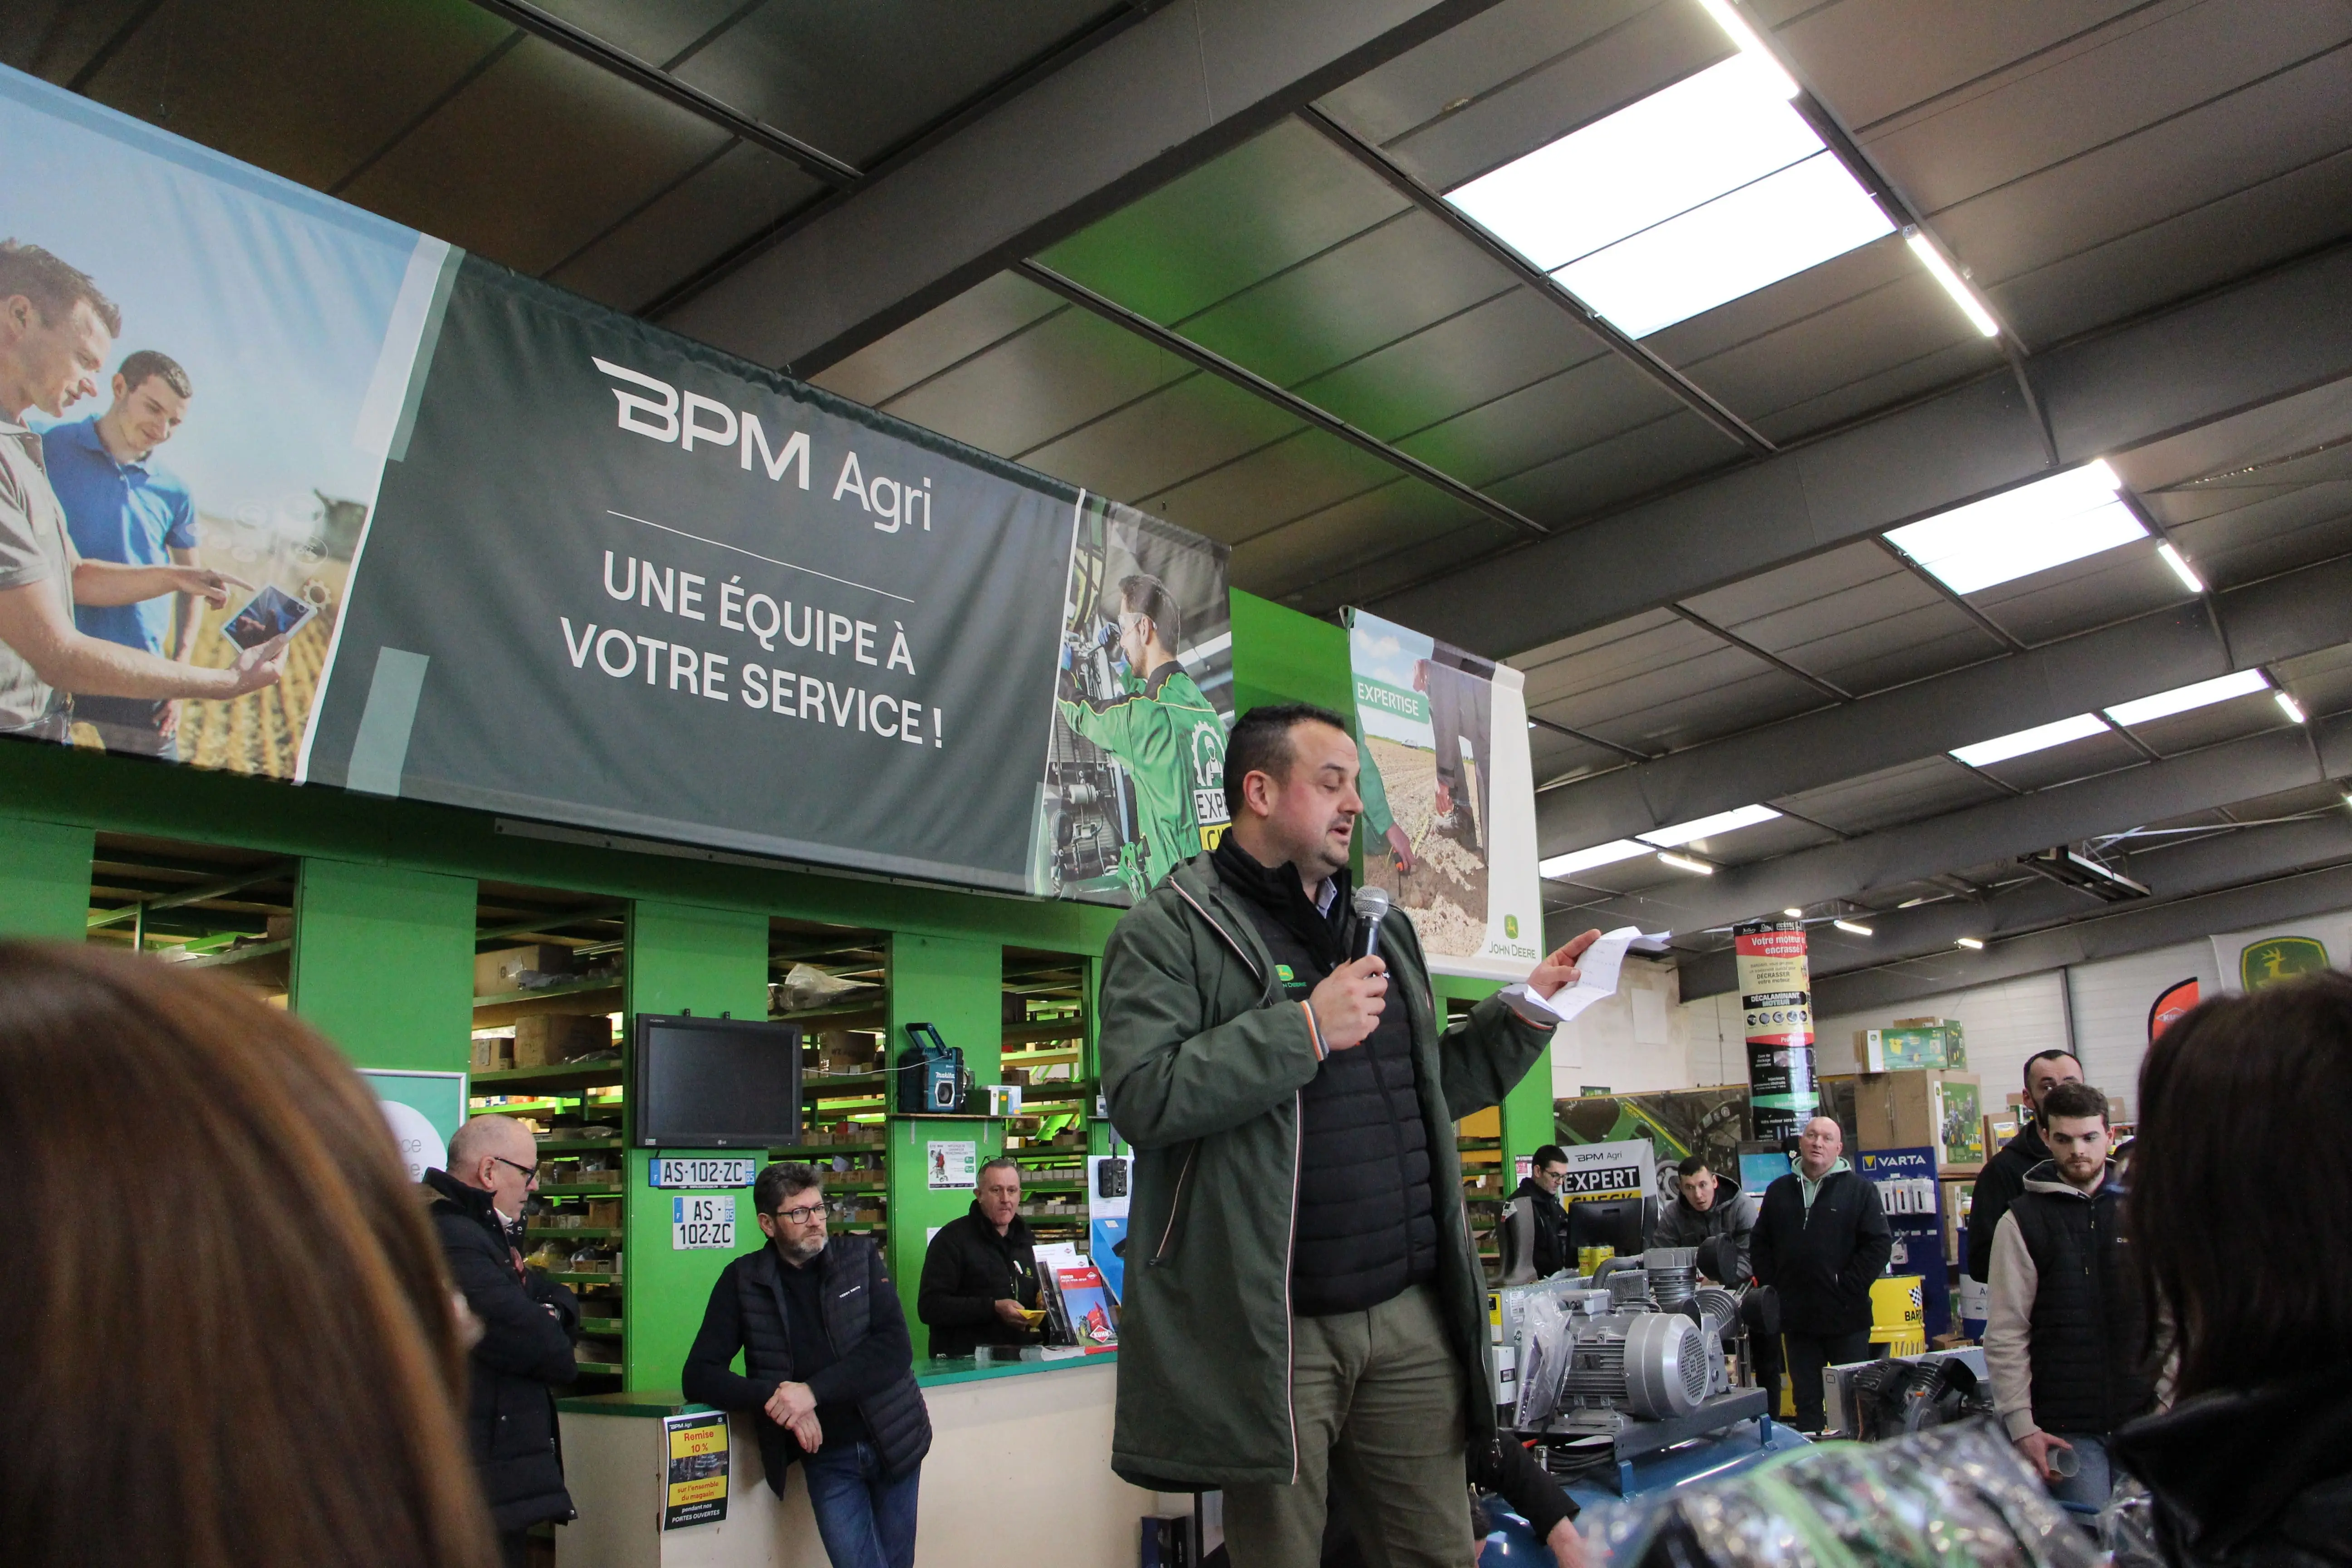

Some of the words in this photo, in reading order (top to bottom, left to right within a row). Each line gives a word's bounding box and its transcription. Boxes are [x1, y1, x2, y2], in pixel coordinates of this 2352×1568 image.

[591, 356, 810, 490] BPM
[833, 451, 931, 533] Agri
[604, 550, 705, 622] UNE
[720, 575, 877, 666] ÉQUIPE
[887, 620, 916, 675] À
[560, 617, 729, 701] VOTRE
[741, 663, 923, 745] SERVICE
[933, 707, 942, 749] !
[1357, 682, 1419, 716] EXPERTISE
[1751, 937, 1774, 946] Votre
[1489, 941, 1510, 956] JOHN
[1511, 944, 1536, 959] DEERE
[1765, 945, 1800, 954] encrassé
[1757, 971, 1790, 980] DÉCRASSER
[1751, 992, 1800, 1002] DÉCALAMINANT
[402, 1139, 422, 1153] ce
[1575, 1152, 1604, 1162] BPM
[1607, 1151, 1622, 1161] Agri
[1877, 1155, 1926, 1167] VARTA
[1564, 1168, 1637, 1192] EXPERT
[1093, 1331, 1109, 1339] KUHN
[684, 1430, 714, 1441] Remise
[691, 1444, 700, 1453] 10
[702, 1442, 708, 1451] %
[688, 1481, 719, 1491] l'ensemble
[690, 1490, 714, 1499] magasin
[682, 1504, 702, 1514] pendant
[672, 1514, 692, 1523] PORTES
[693, 1509, 720, 1519] OUVERTES
